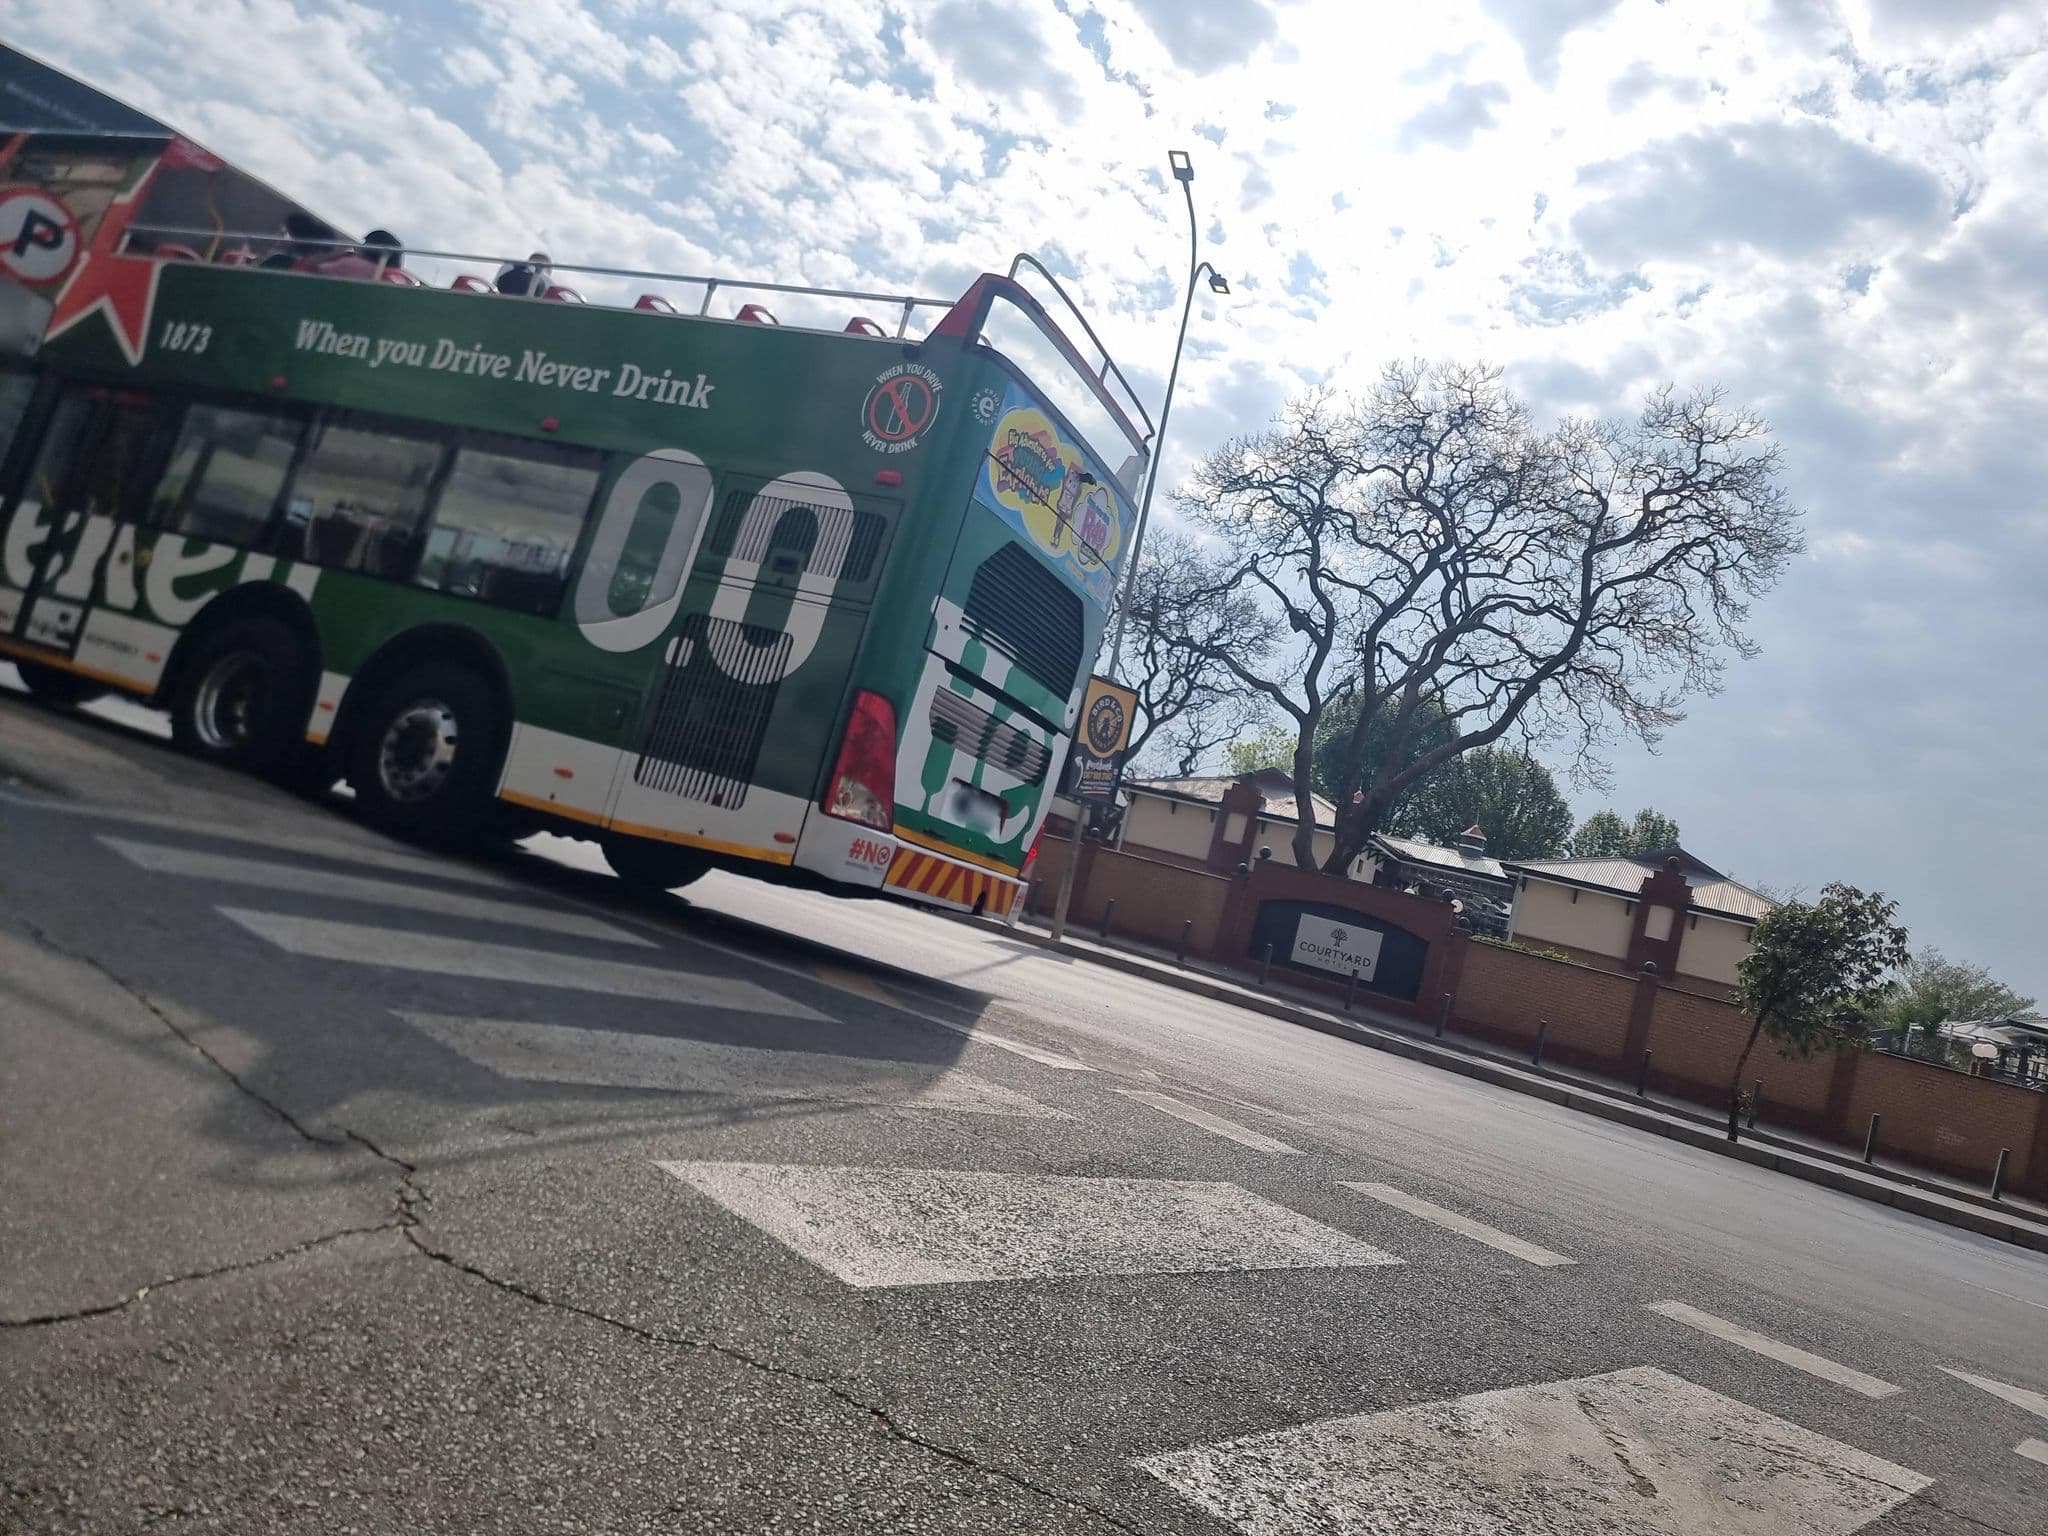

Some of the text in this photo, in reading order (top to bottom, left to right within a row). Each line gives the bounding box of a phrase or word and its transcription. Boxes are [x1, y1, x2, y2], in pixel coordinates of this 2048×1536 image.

[160, 320, 212, 354] 1873
[296, 319, 716, 410] When you Drive Never Drink
[876, 363, 943, 393] WHEN YOU DRIVE
[861, 430, 918, 454] NEVER DRINK
[1092, 698, 1111, 717] BIRD
[1299, 941, 1371, 967] COURTYARD
